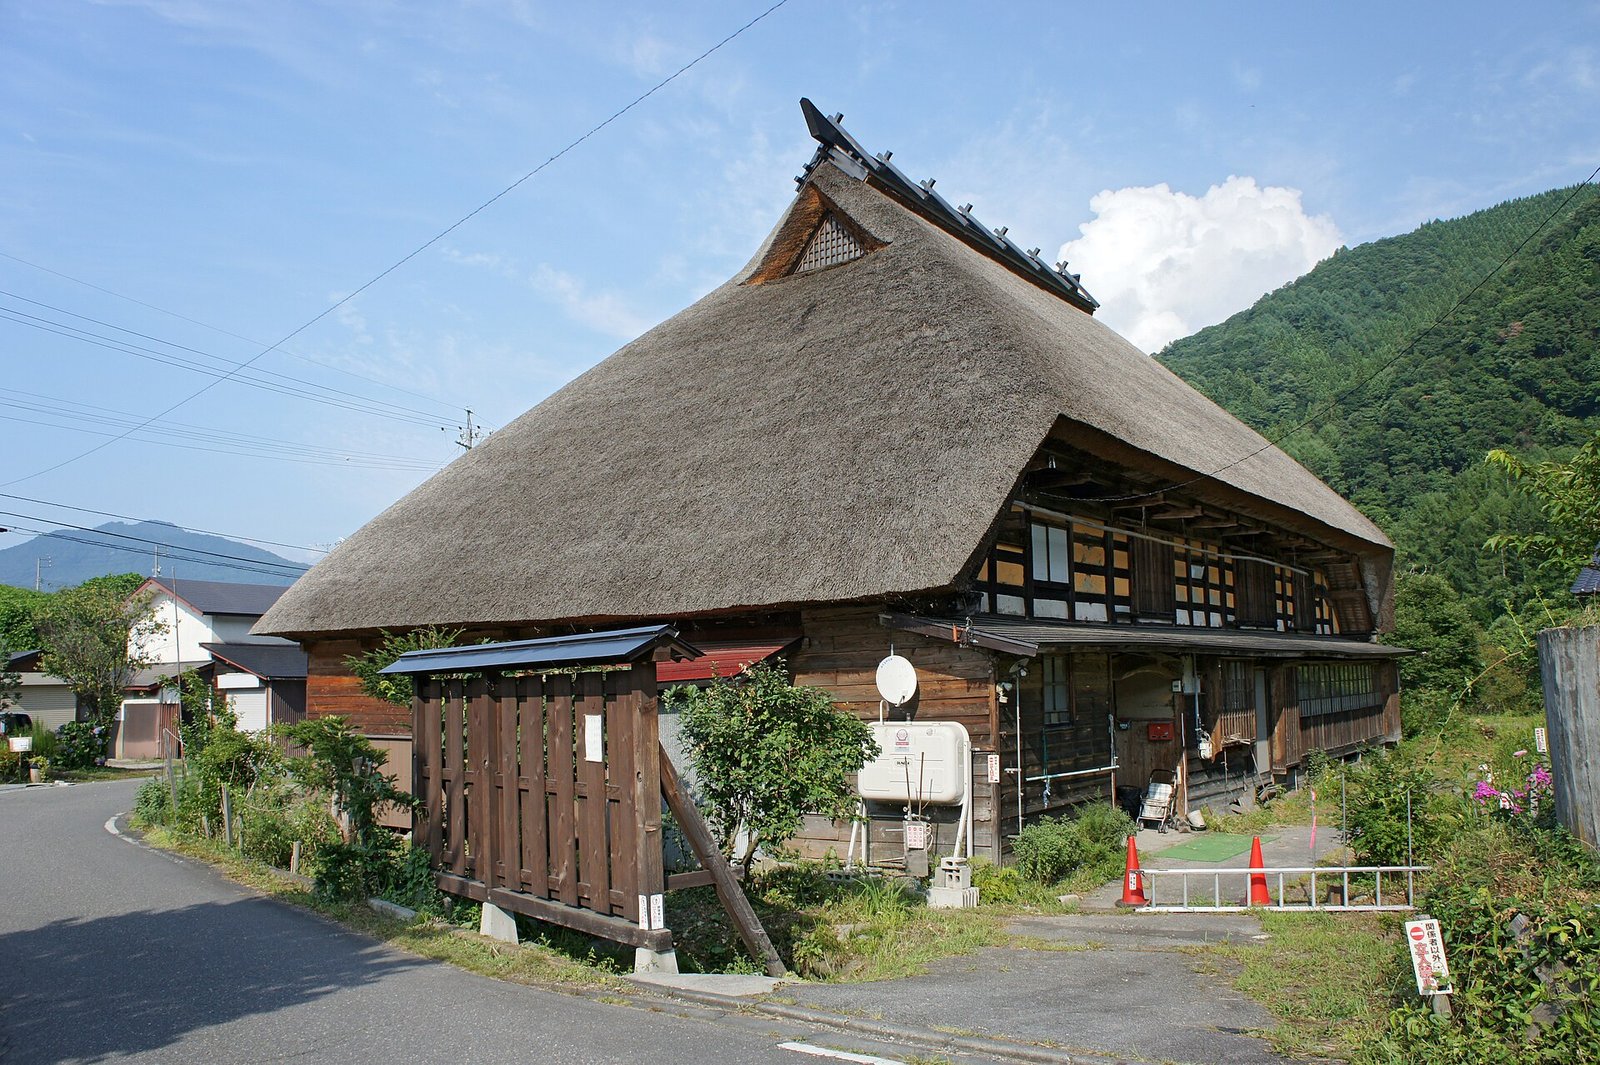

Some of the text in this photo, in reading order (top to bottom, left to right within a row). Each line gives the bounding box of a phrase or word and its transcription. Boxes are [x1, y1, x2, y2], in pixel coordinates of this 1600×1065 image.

[1425, 923, 1441, 962] 関係者以外
